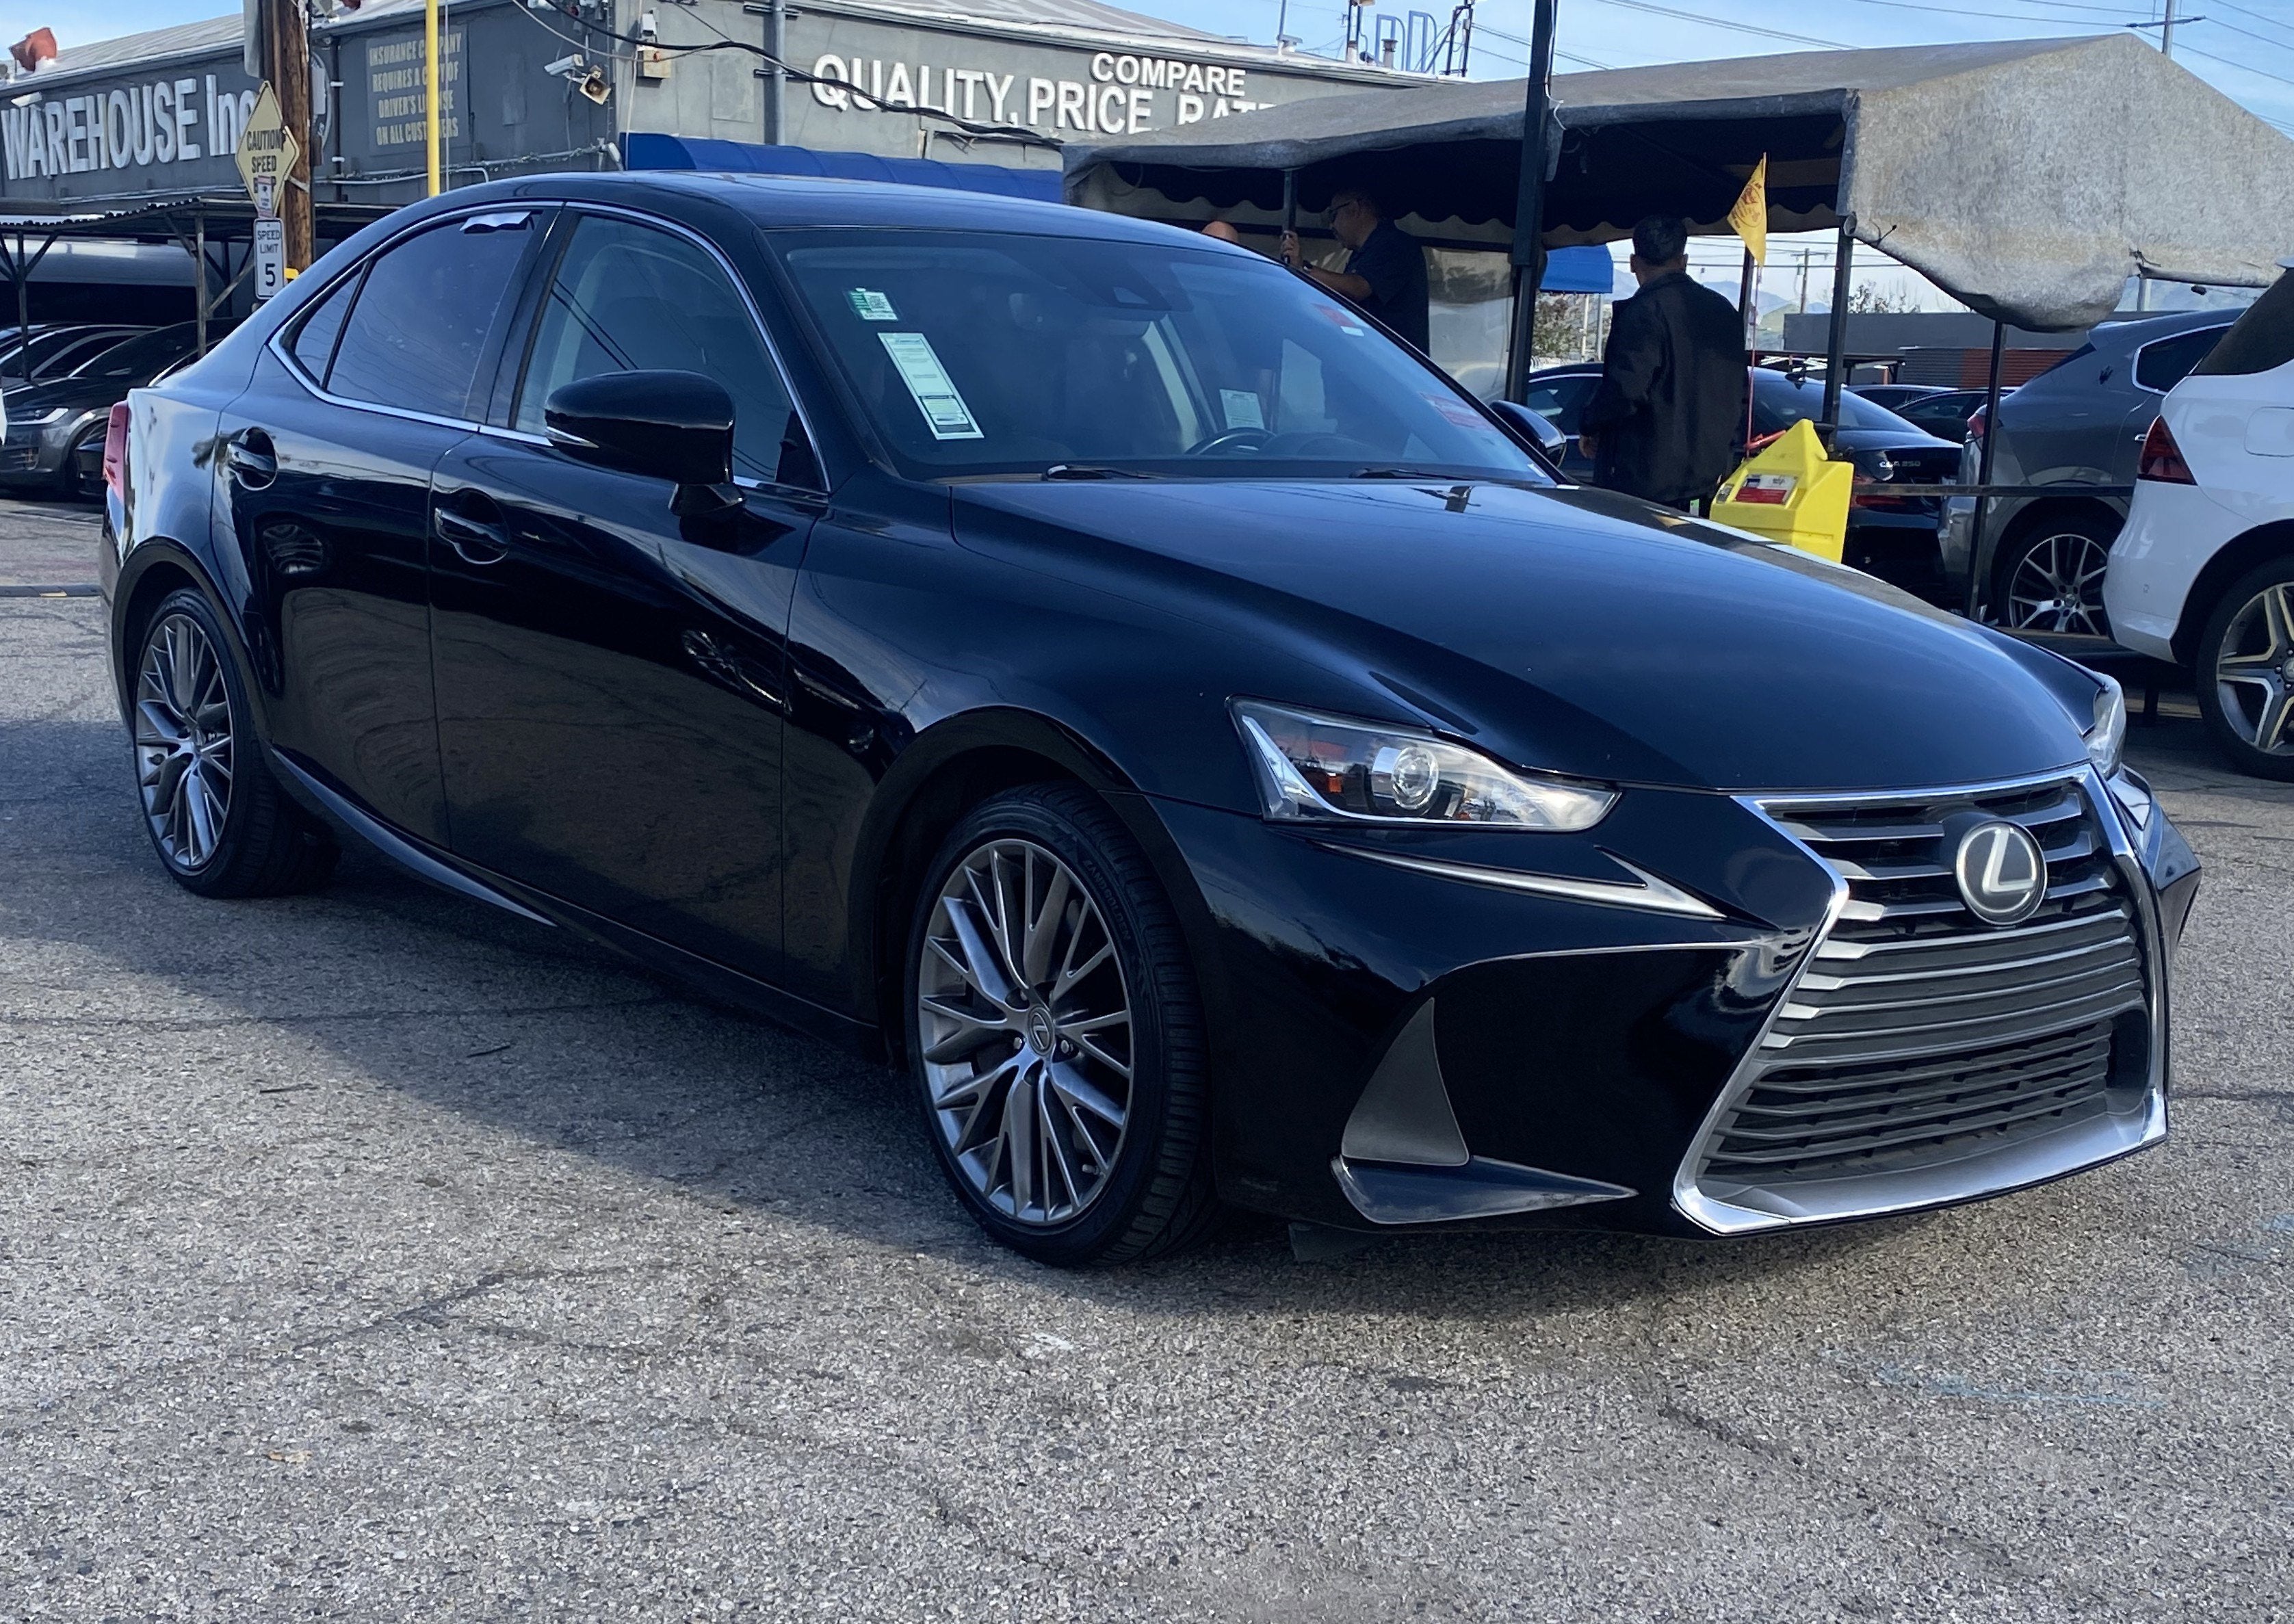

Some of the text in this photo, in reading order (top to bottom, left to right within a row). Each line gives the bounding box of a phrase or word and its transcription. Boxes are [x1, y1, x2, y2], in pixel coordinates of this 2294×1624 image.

[369, 32, 461, 66] INSURANCE CPANY
[372, 68, 413, 93] REQUIRES
[414, 67, 420, 86] A
[1091, 52, 1247, 97] COMPARE
[809, 53, 1015, 127] QUALITY,
[378, 94, 415, 118] DRIVER'S
[1, 77, 201, 180] WAREHOUSE
[376, 125, 389, 146] ON
[390, 124, 404, 144] ALL
[251, 155, 277, 173] SPEED
[257, 229, 281, 241] SPEED
[259, 243, 279, 254] LIMIT
[265, 263, 276, 287] 5
